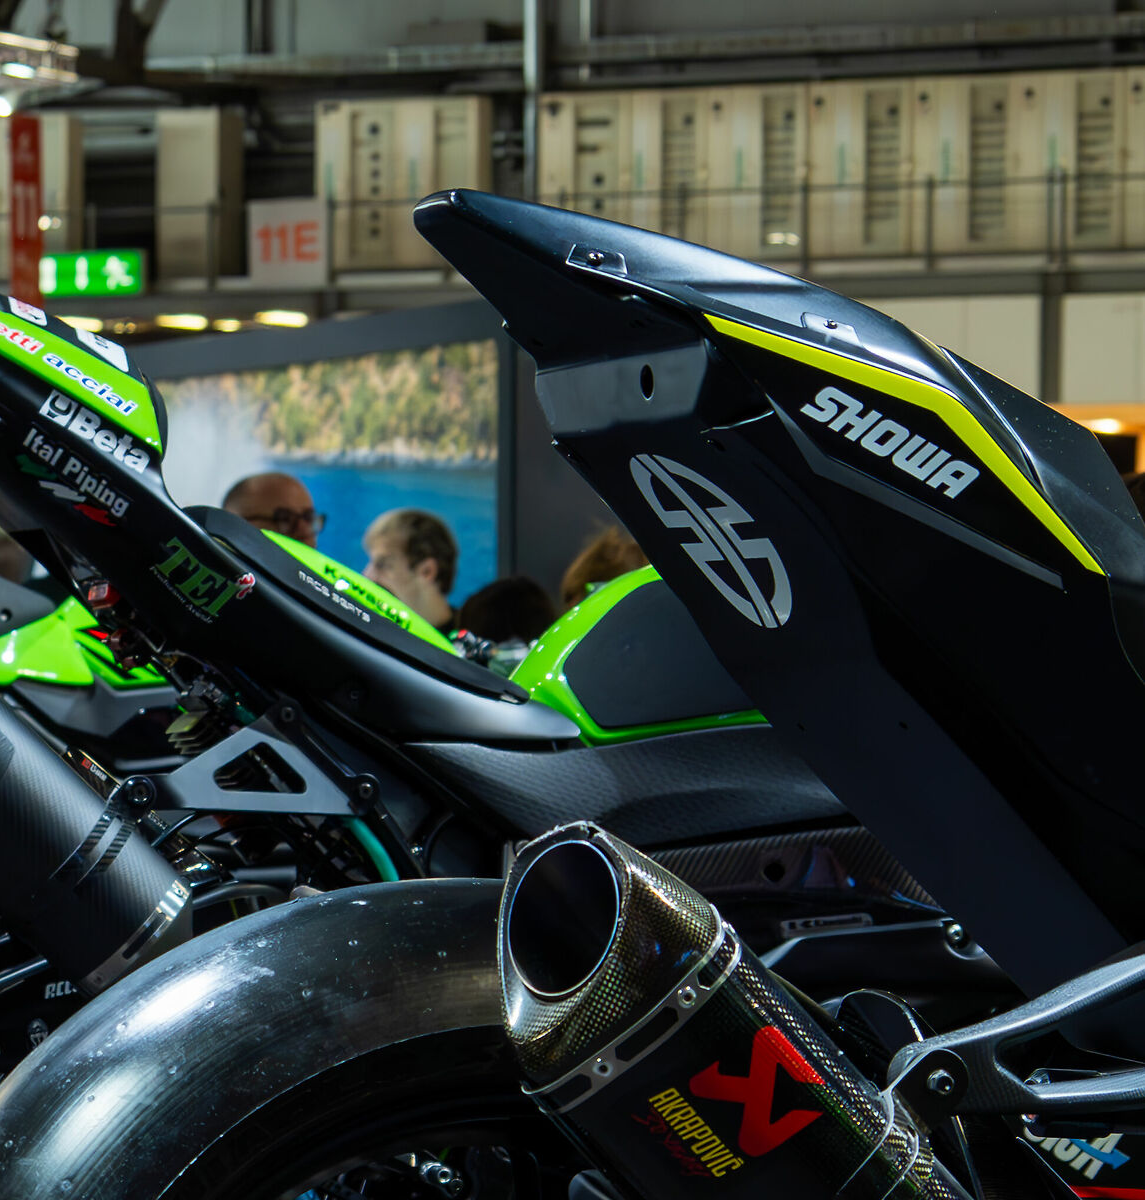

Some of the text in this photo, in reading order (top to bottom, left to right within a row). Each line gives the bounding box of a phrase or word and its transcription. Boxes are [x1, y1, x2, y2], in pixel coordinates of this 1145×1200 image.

[257, 221, 320, 263] 11E
[43, 353, 139, 417] acciai
[22, 427, 130, 518] Ital Piping
[67, 406, 151, 474] Beta
[800, 386, 980, 499] SHOWA
